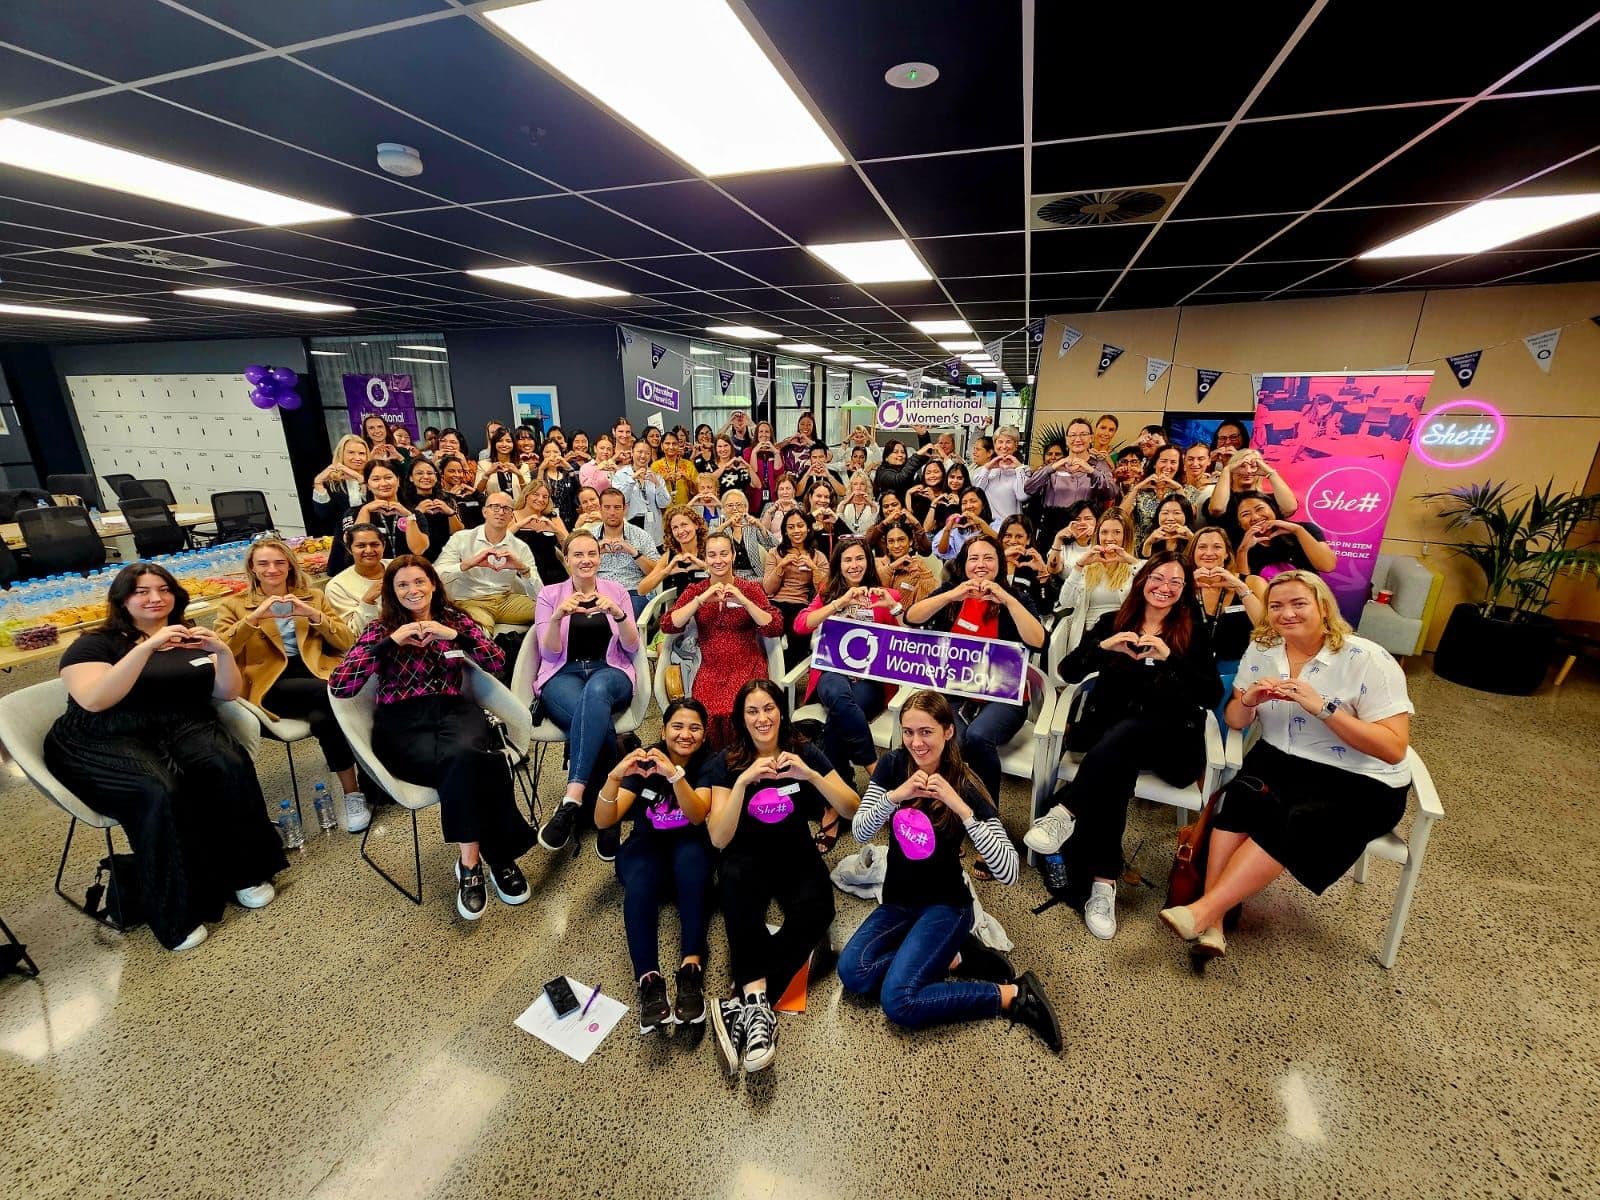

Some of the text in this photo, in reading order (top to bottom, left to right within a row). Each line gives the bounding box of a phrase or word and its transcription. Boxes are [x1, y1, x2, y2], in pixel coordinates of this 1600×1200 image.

[906, 398, 982, 409] International
[906, 413, 986, 426] Women's Day
[1422, 423, 1495, 445] She#
[1313, 489, 1382, 513] She#
[886, 654, 957, 681] Women's
